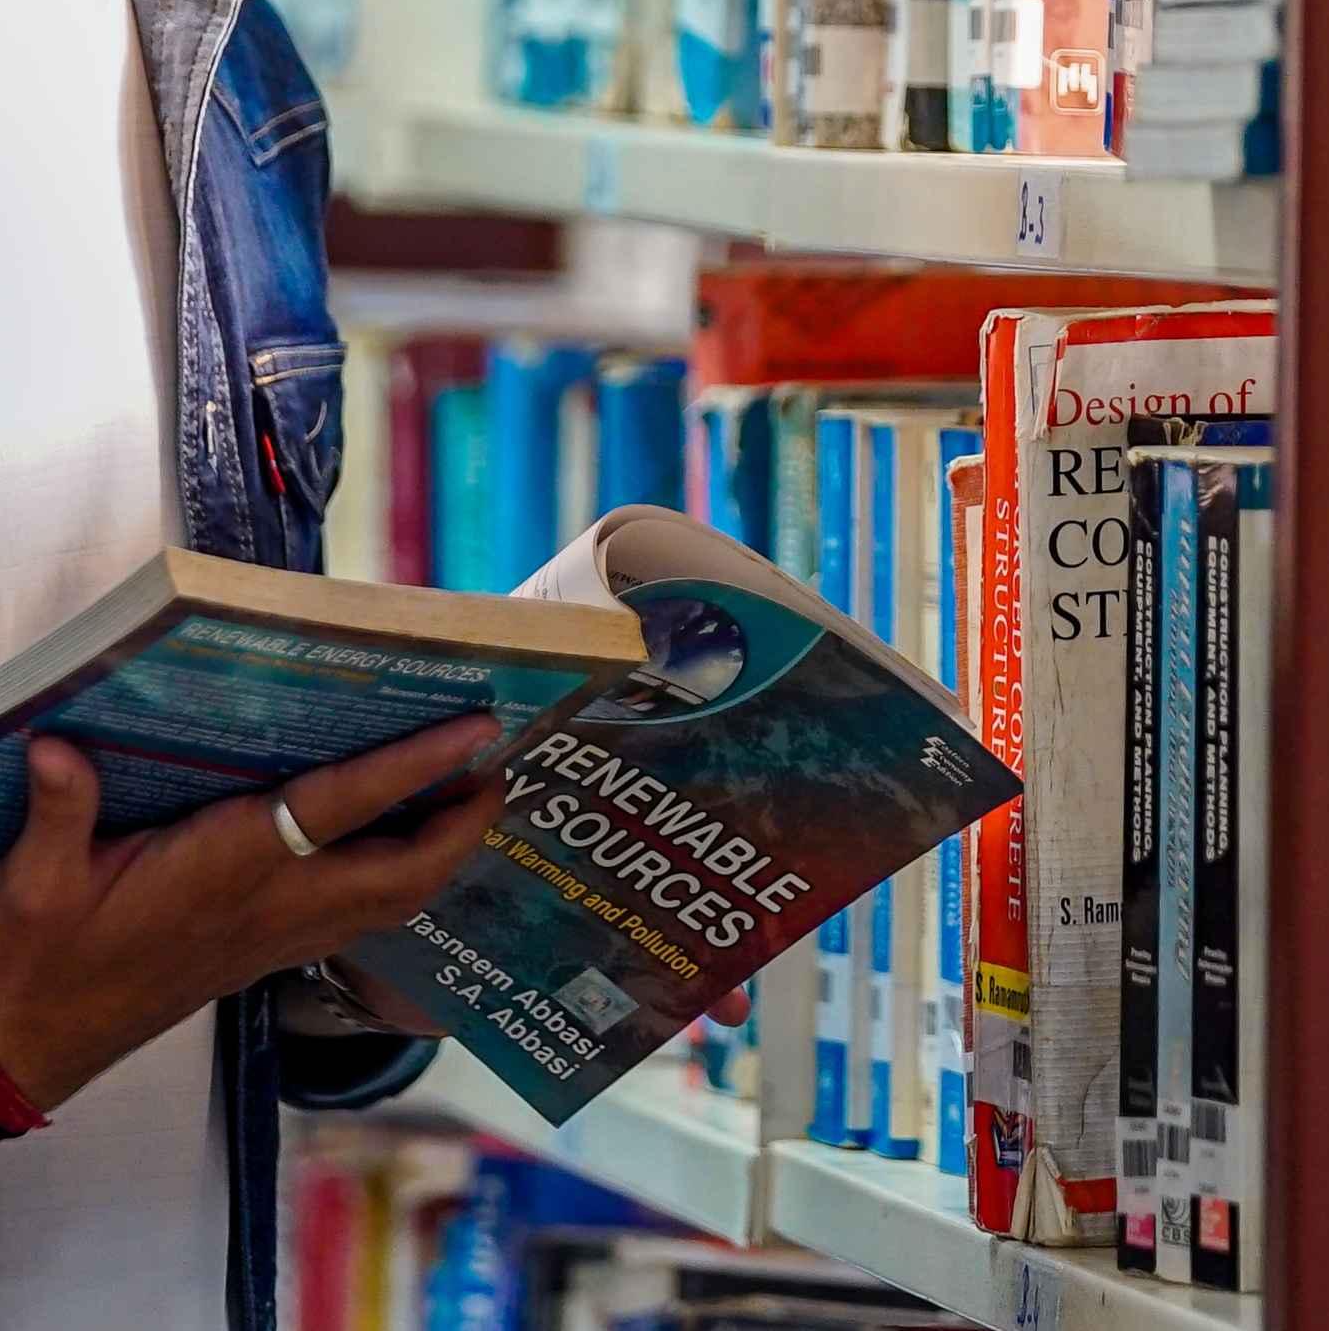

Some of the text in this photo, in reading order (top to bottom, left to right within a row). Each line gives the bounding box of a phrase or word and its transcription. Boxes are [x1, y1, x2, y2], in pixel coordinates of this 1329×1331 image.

[1047, 378, 1256, 429] Design of
[1047, 446, 1126, 497] RE
[1048, 517, 1130, 569] CO
[180, 621, 311, 657] RENEWABLE
[304, 644, 391, 669] ENERGY
[389, 657, 492, 683] SOURCES
[1132, 539, 1144, 863] EQUIPMENT, AND METHODS
[1143, 541, 1153, 858] CONSTRUCTION PLANNING,
[1205, 535, 1217, 861] EQUIPMENT, AND METHODS
[1217, 537, 1229, 855] CONSTRUCTION PLANNING,
[504, 767, 756, 949] Y SOURCES
[523, 731, 812, 914] RENEWABLE
[1008, 681, 1024, 922] CONRETE
[507, 839, 589, 901] Warming
[581, 893, 629, 923] and
[618, 912, 702, 981] Pollution
[1060, 896, 1120, 926] S. Ram
[405, 910, 606, 1061] Tasneem Abbasi
[435, 964, 581, 1081] S.A. Abbasi
[975, 971, 986, 1004] S.
